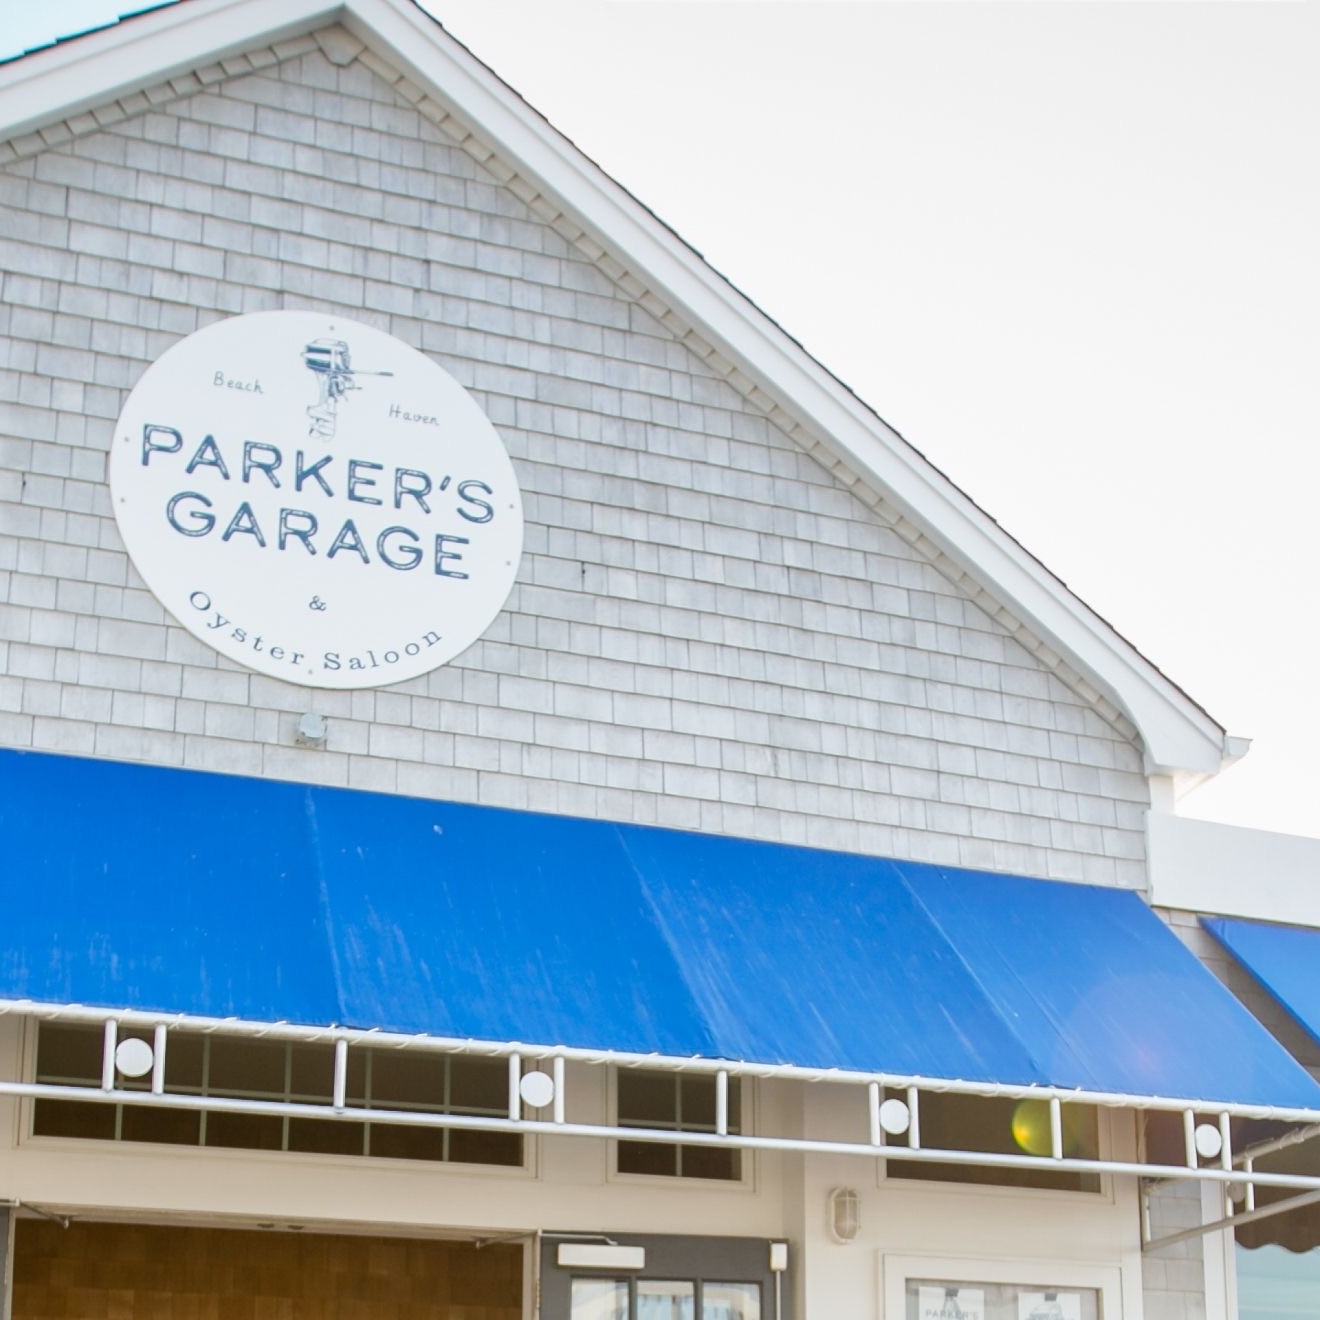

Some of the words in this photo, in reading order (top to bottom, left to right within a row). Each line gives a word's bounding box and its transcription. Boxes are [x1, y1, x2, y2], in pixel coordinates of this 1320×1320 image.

[213, 370, 264, 395] Beach
[388, 403, 440, 427] Haven
[141, 423, 495, 524] PARKER'S
[166, 491, 470, 580] GARAGE
[189, 590, 305, 665] Oyster
[323, 630, 443, 671] Saloon
[308, 595, 327, 612] &
